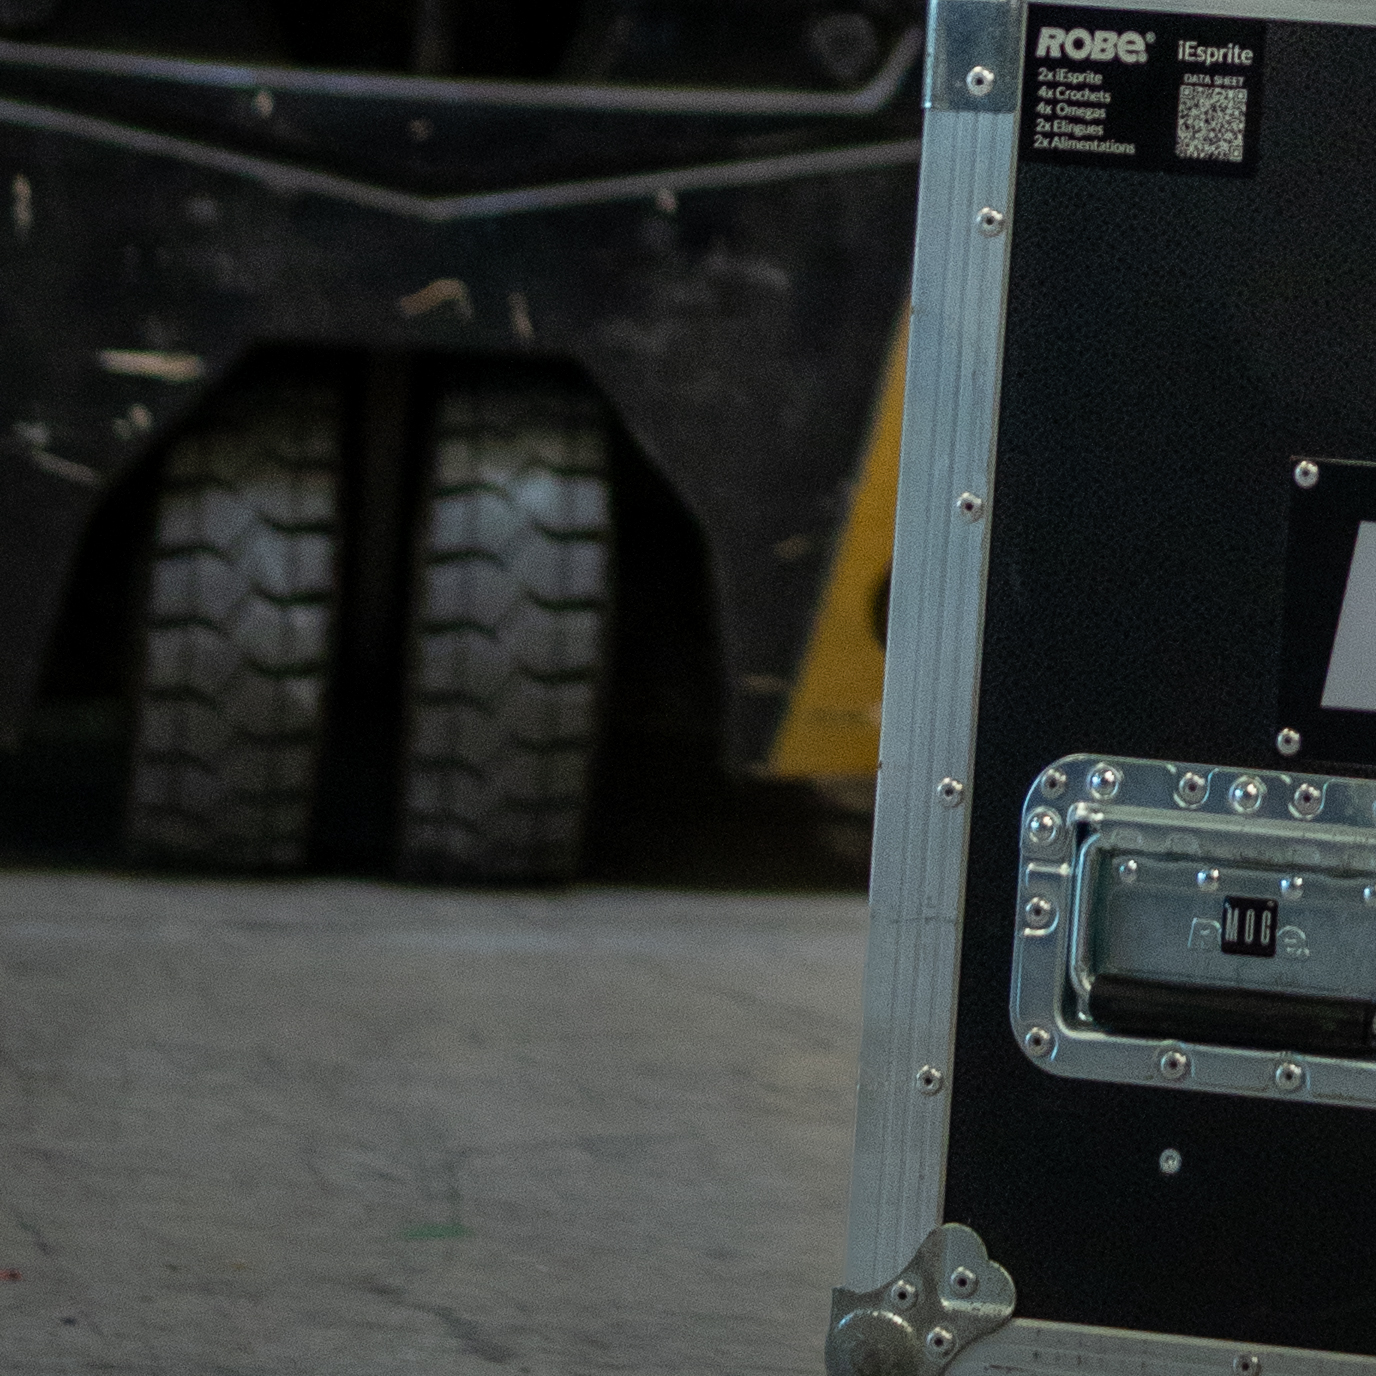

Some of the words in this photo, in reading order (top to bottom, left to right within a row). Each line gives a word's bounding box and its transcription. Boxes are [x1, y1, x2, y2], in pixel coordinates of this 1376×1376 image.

[1177, 39, 1254, 66] iEsprite
[1037, 67, 1054, 82] 2x
[1055, 68, 1103, 85] iEsprite
[1184, 73, 1211, 84] DATA
[1037, 85, 1054, 99] 4x
[1055, 86, 1112, 104] Crochets
[1036, 101, 1053, 115] 4x
[1036, 118, 1051, 132] 2x
[1034, 134, 1050, 148] 2x
[1051, 136, 1136, 155] Alimentations
